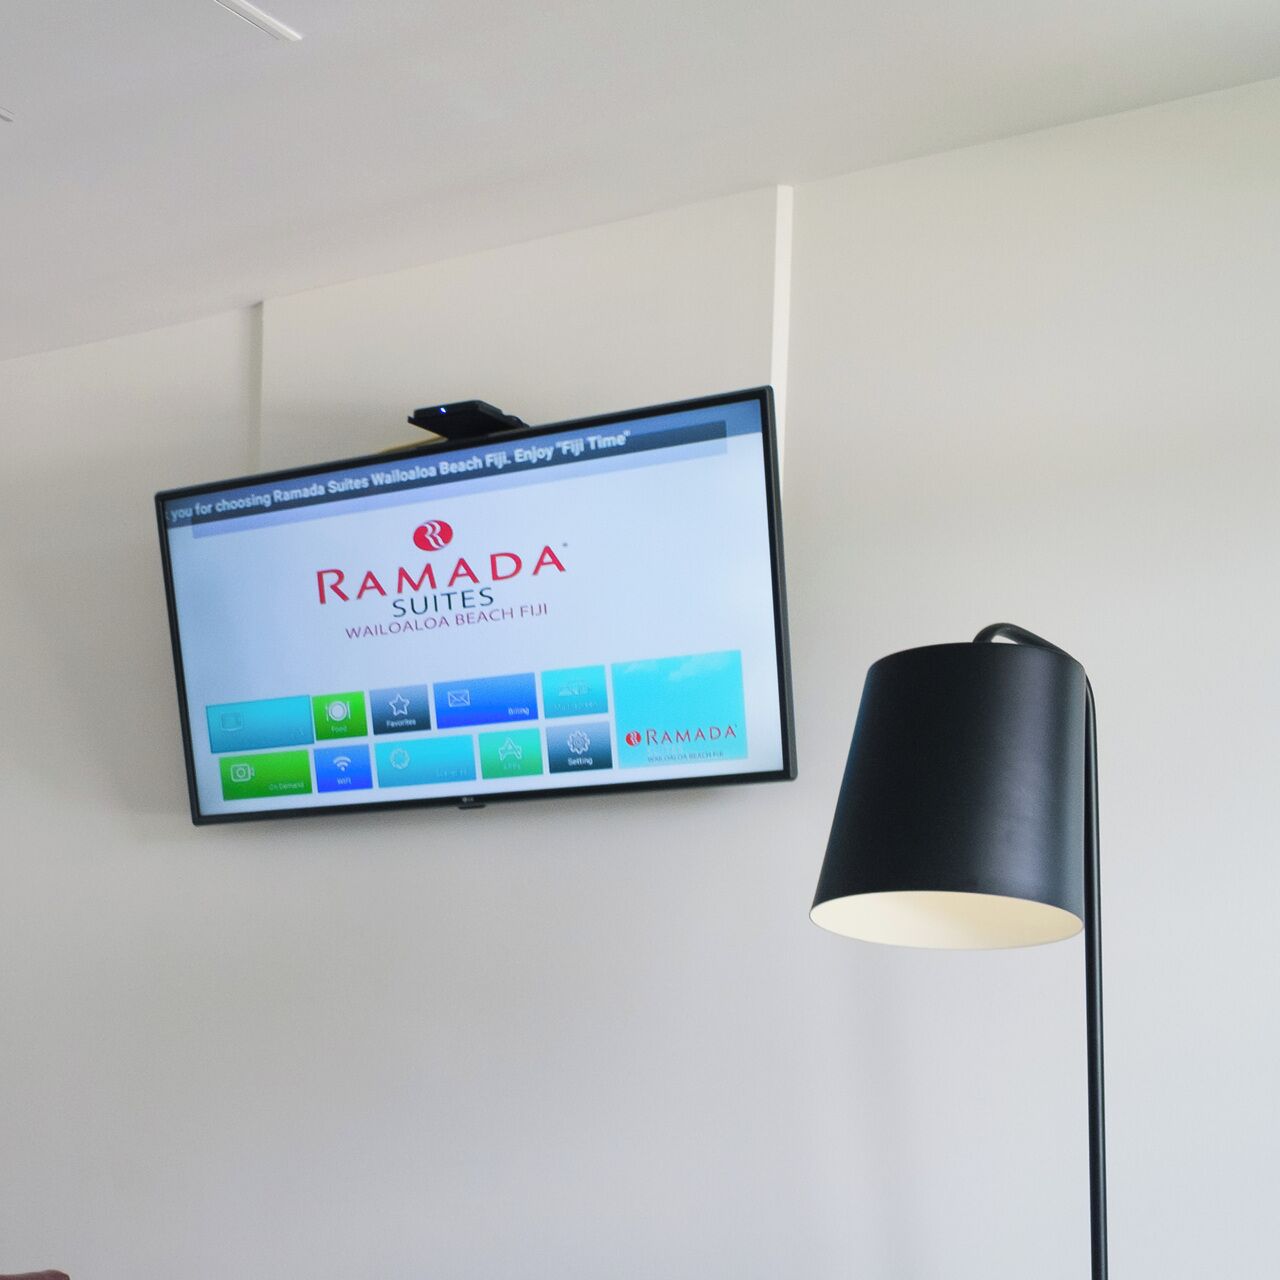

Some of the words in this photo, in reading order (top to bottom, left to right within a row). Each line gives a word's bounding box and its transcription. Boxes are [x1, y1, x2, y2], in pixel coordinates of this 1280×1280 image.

[171, 508, 193, 522] you
[195, 502, 212, 516] for
[215, 493, 272, 513] choosing
[273, 483, 325, 503] Ramada
[327, 477, 369, 493] Suites
[371, 464, 437, 486] Wailoaloa
[440, 456, 483, 476] Beach
[486, 451, 510, 470] Fiji.
[514, 445, 554, 464] Enjoy
[316, 545, 566, 605] RAMADA
[392, 587, 495, 618] SUITES
[345, 616, 450, 640] WAILOALOA
[455, 606, 514, 626] BEACH
[520, 603, 548, 619] FIJI
[386, 718, 417, 728] Favorites
[646, 725, 737, 746] RAMADA
[567, 757, 593, 767] Setting
